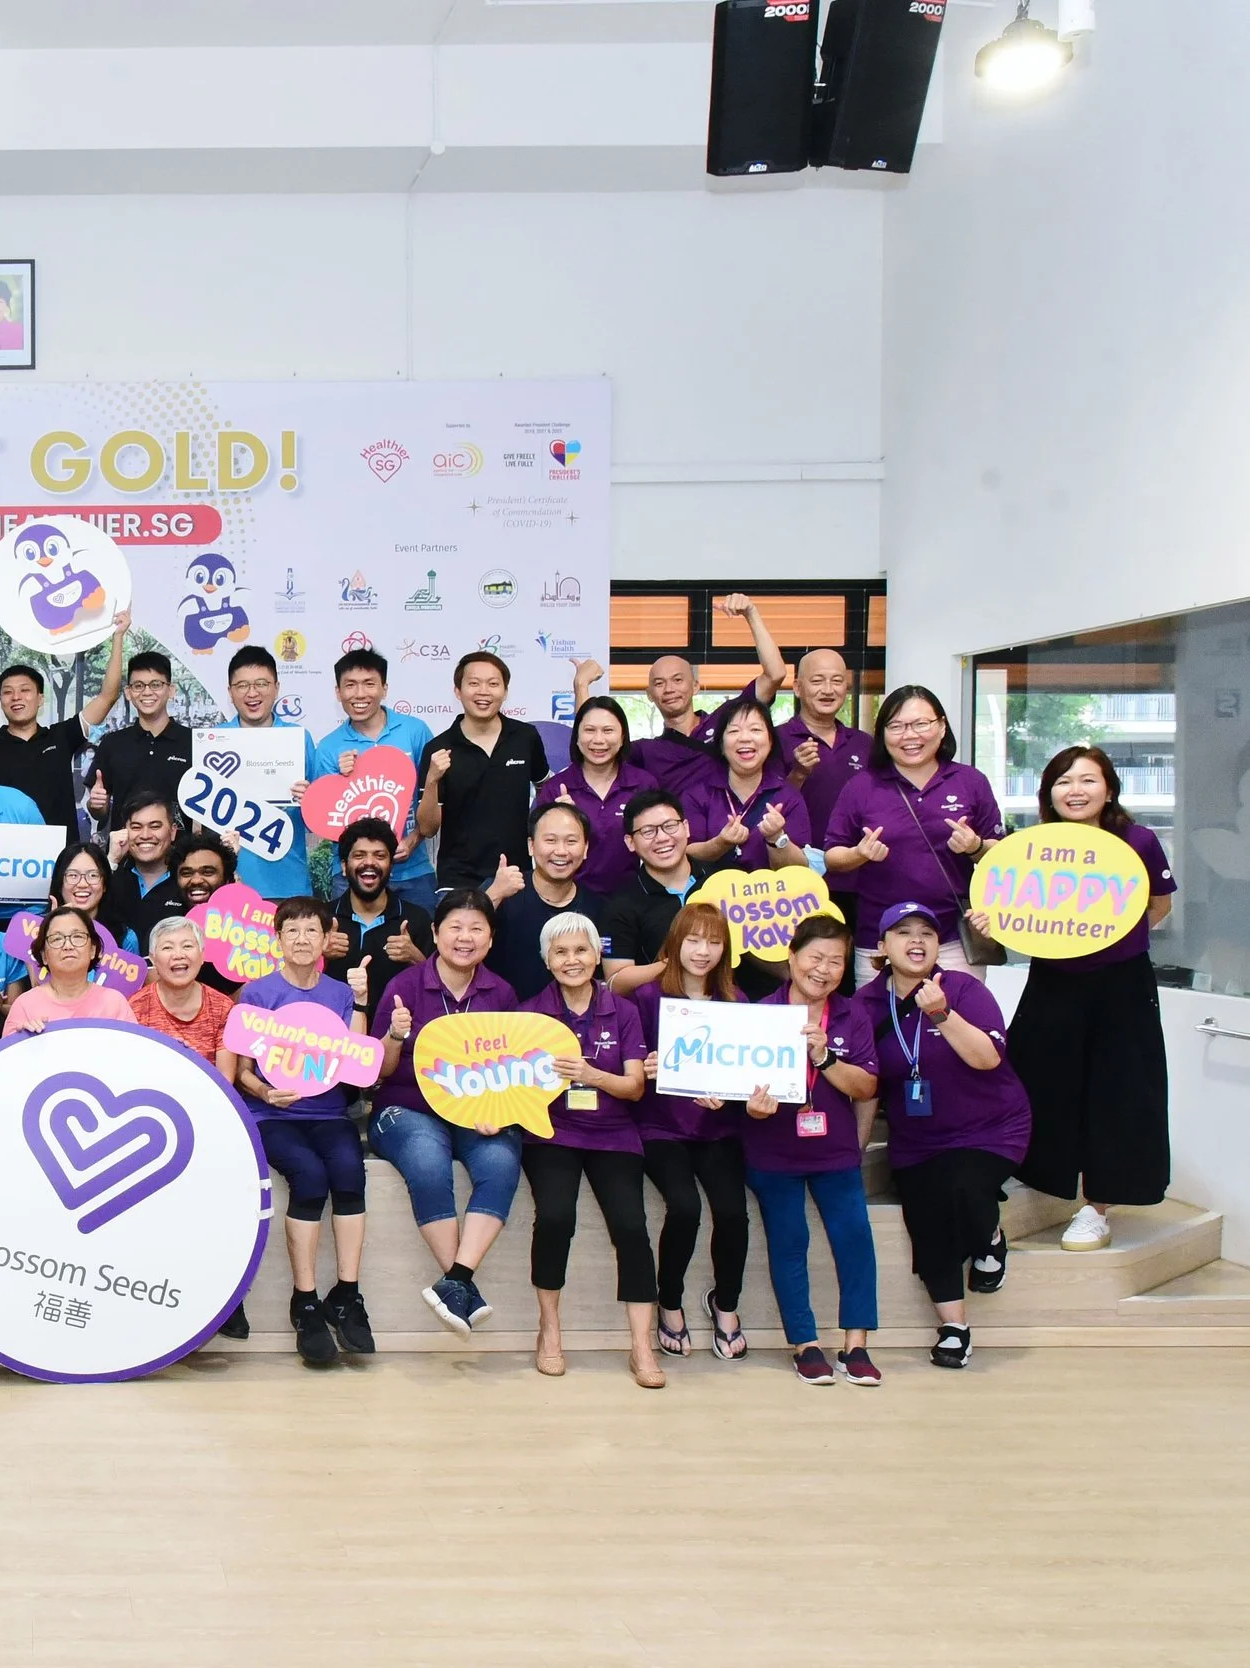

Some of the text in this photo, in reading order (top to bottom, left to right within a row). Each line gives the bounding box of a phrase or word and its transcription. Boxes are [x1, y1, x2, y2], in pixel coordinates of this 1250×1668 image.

[30, 430, 298, 493] GOLD!
[360, 439, 410, 461] Healthier
[375, 460, 396, 471] SG
[528, 495, 568, 504] Certificate
[492, 508, 562, 518] of Commendation
[503, 520, 552, 529] (COVID-19)
[395, 544, 458, 553] Event Partners
[420, 645, 451, 657] C3A
[396, 706, 409, 714] SG
[246, 759, 295, 767] Blossom Seeds
[327, 774, 405, 827] Healthier
[184, 772, 286, 855] 2024
[1025, 842, 1096, 865] I am a
[731, 880, 786, 898] I am a
[982, 866, 1139, 917] HAPPY
[241, 903, 275, 927] I am
[720, 893, 820, 924] lossom
[998, 912, 1116, 940] Volunteer
[241, 1010, 375, 1067] Volunteering
[464, 1034, 508, 1055] I feel
[264, 1045, 340, 1086] FUN!
[673, 1036, 795, 1073] Micron
[428, 1050, 563, 1098] Young
[93, 1264, 182, 1309] Seeds
[33, 1290, 94, 1330] 福善
